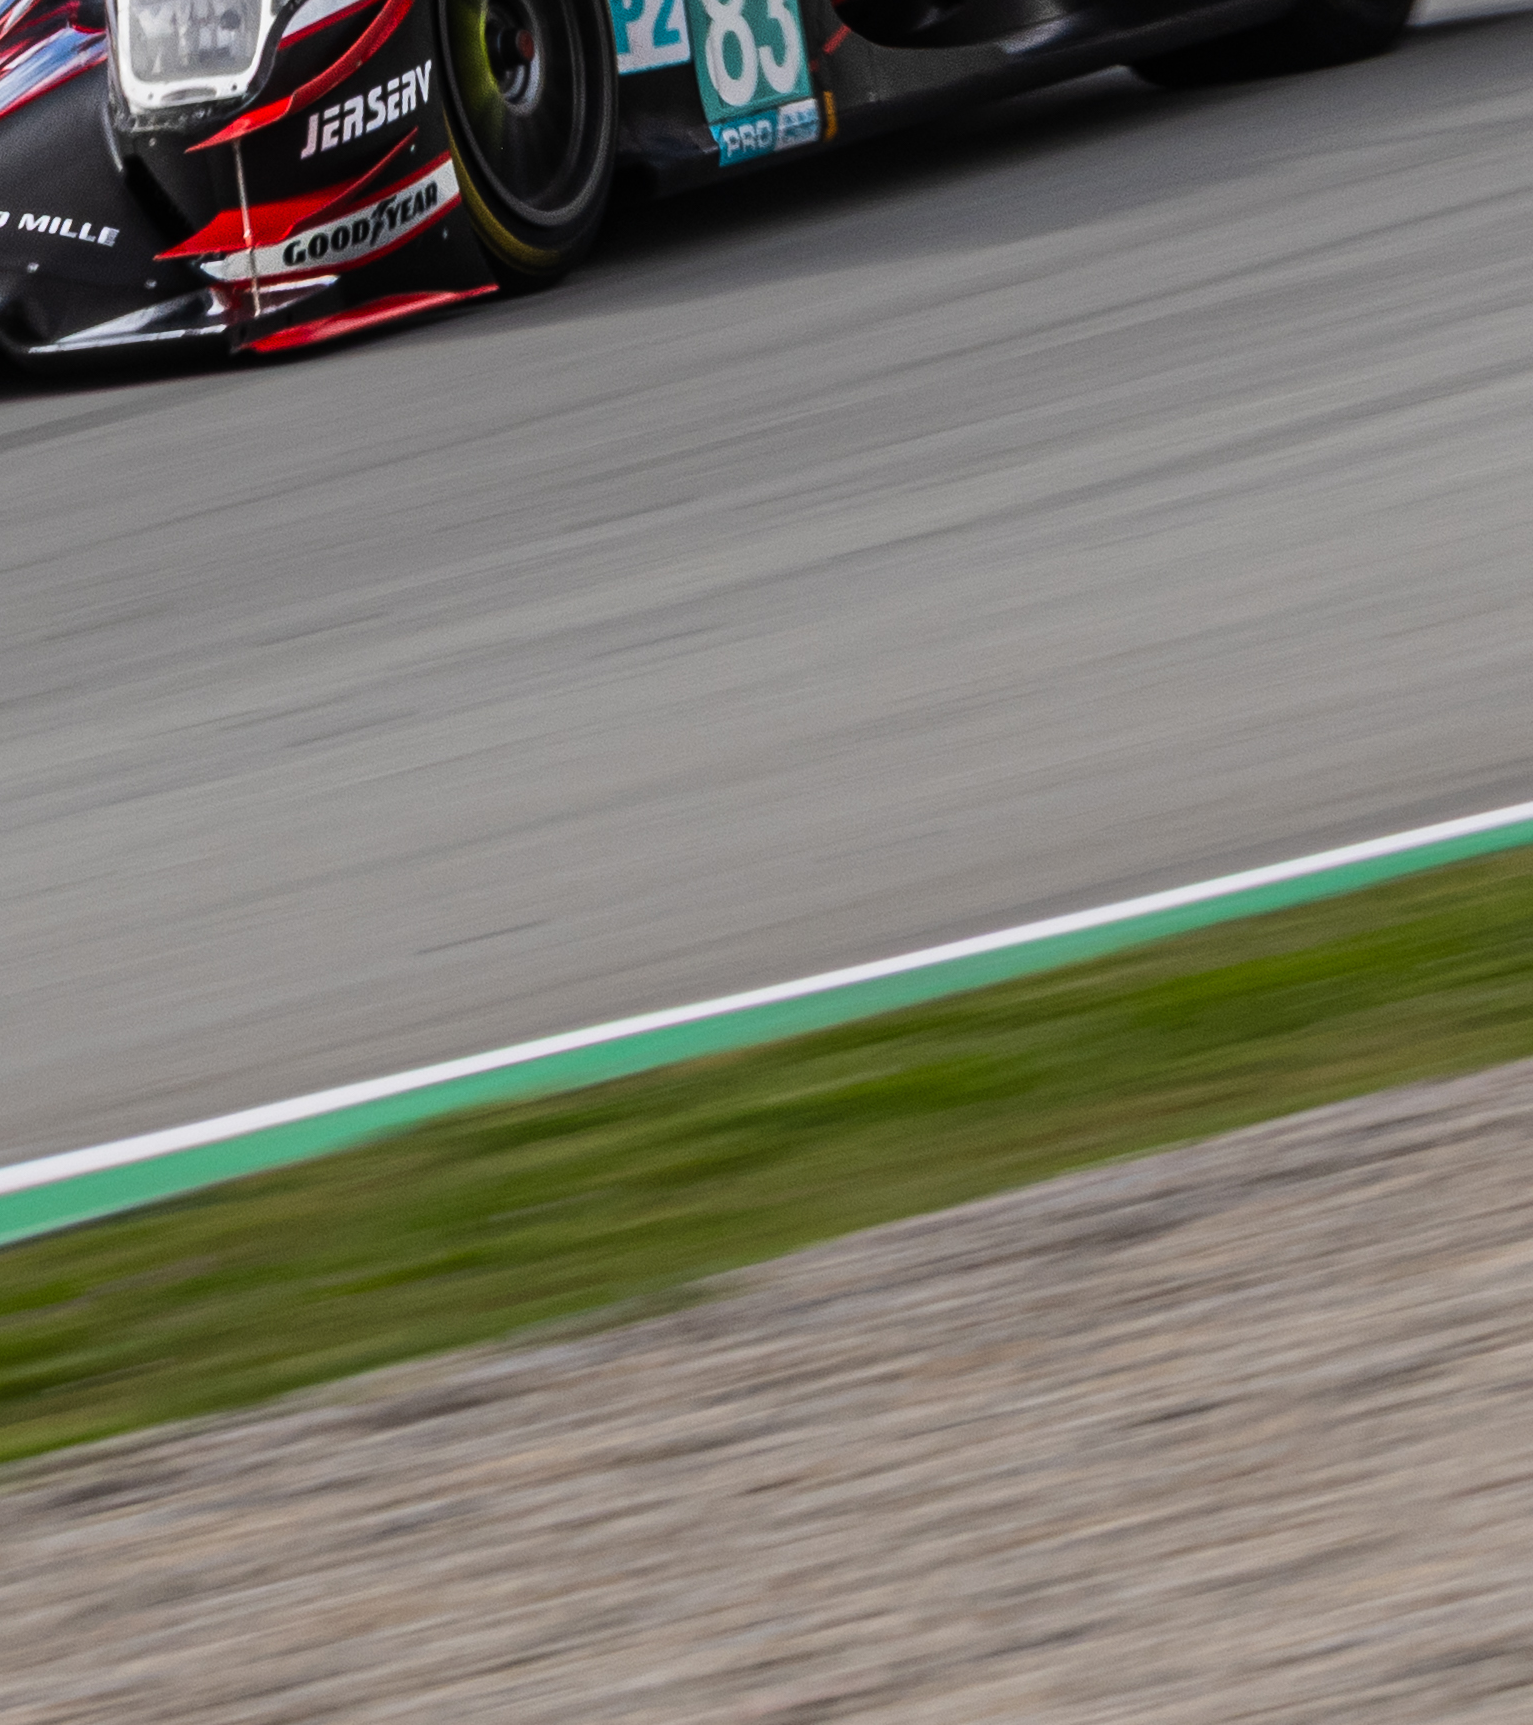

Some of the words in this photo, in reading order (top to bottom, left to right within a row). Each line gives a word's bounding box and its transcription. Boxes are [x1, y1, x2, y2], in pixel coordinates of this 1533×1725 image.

[300, 58, 432, 160] JERSERV
[18, 213, 120, 248] MILLE
[282, 180, 438, 267] GOODYEAR
